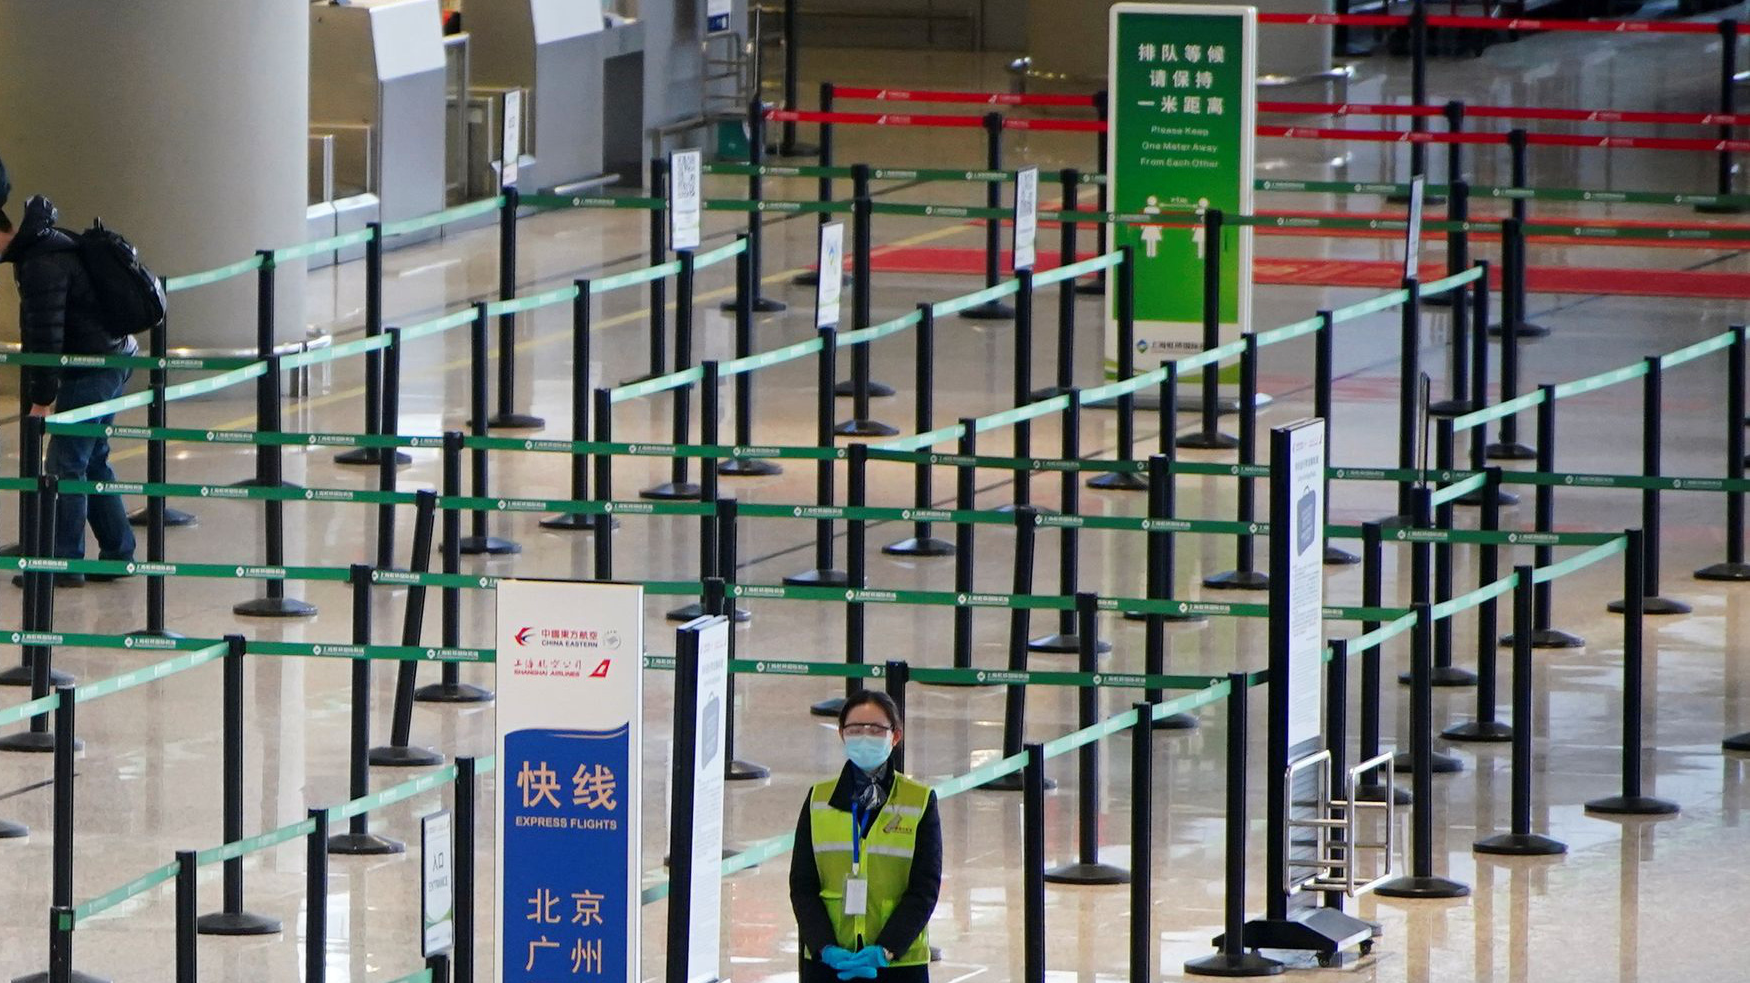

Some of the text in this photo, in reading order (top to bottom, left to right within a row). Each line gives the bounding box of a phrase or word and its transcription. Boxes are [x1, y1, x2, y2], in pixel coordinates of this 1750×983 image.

[1138, 43, 1225, 63] 排队等候
[1149, 69, 1213, 89] 请保持
[1137, 95, 1223, 115] 一米距离
[1151, 125, 1209, 136] Please Keep
[1141, 141, 1217, 153] One Meter Away
[1140, 157, 1218, 168] From Each Other
[516, 760, 617, 811] 快线
[515, 816, 617, 830] EXPRESS FLIGHTS
[526, 888, 605, 927] 北京
[525, 935, 602, 974] 广州
